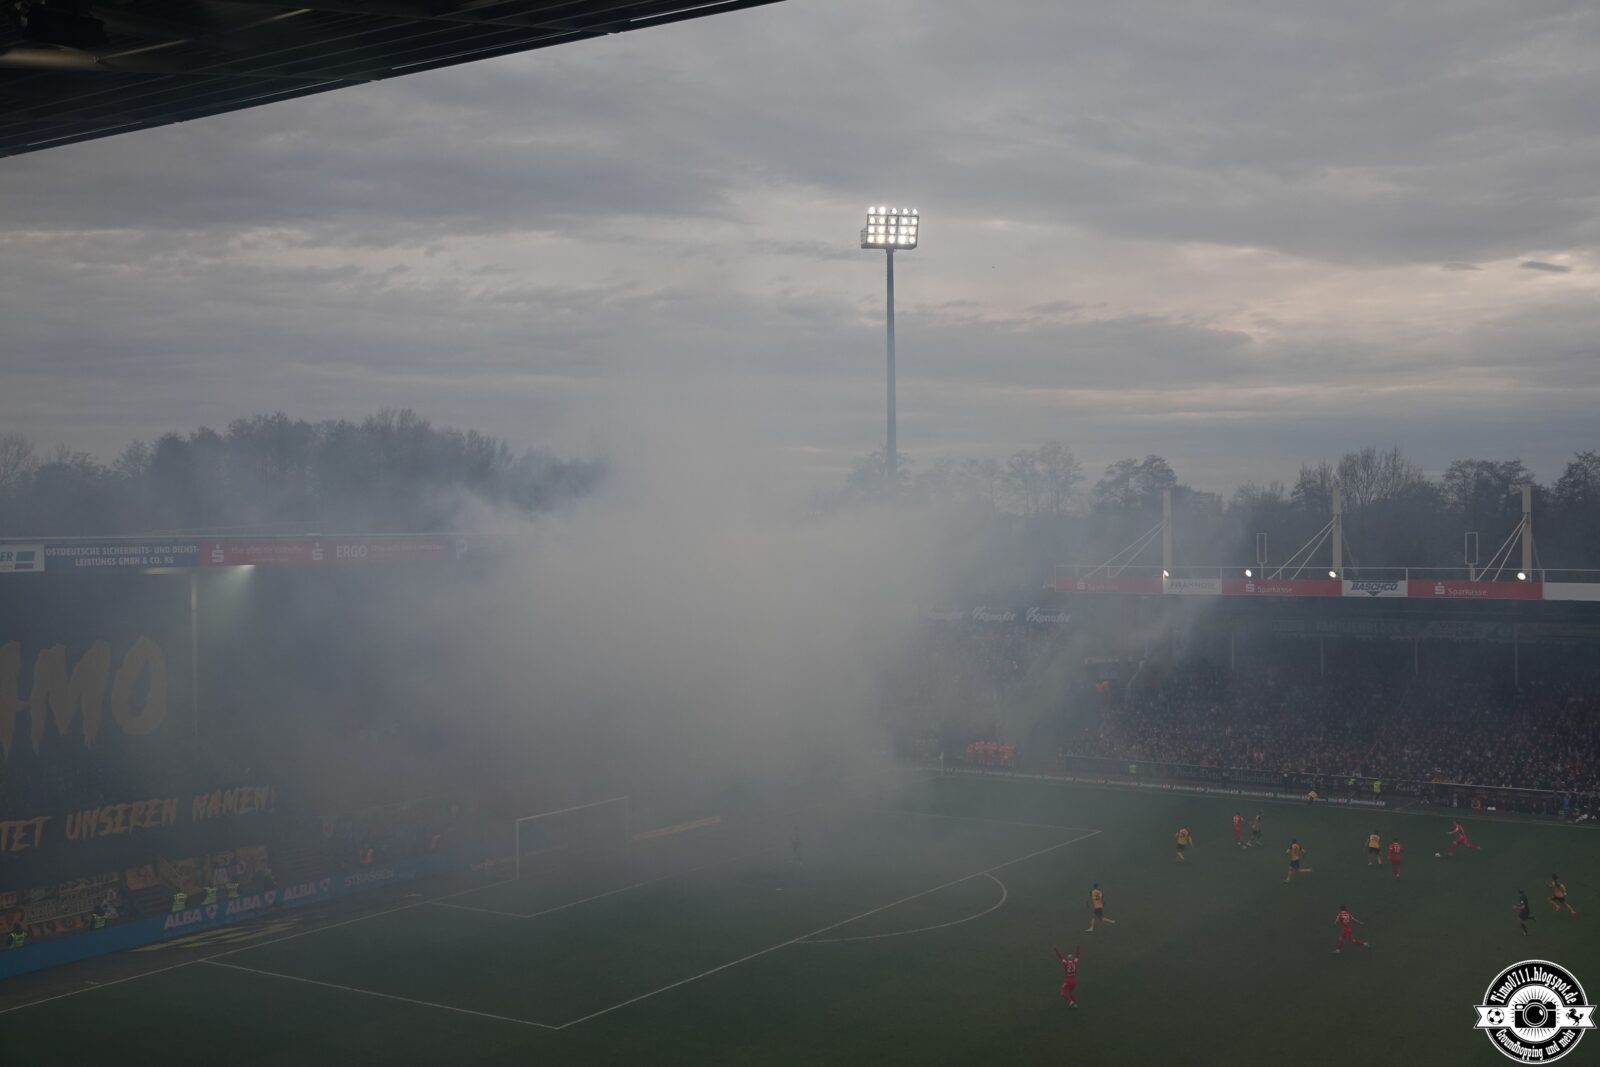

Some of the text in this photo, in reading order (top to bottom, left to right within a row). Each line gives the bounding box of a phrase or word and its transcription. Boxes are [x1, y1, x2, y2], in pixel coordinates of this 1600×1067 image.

[46, 545, 201, 556] OSTDEUTSCHE SICHERHEITS- UND DIENST-
[336, 544, 368, 558] ERGO
[118, 556, 140, 566] GMBH
[1257, 585, 1294, 595] Sparkasse
[1352, 582, 1399, 592] BASCHCO
[1448, 586, 1488, 597] Sparkasse
[65, 797, 178, 840] UNSEREN
[191, 784, 277, 823] NAMEN!
[283, 882, 317, 901] ALBA
[225, 895, 261, 915] ALBA
[164, 909, 203, 929] ALBA
